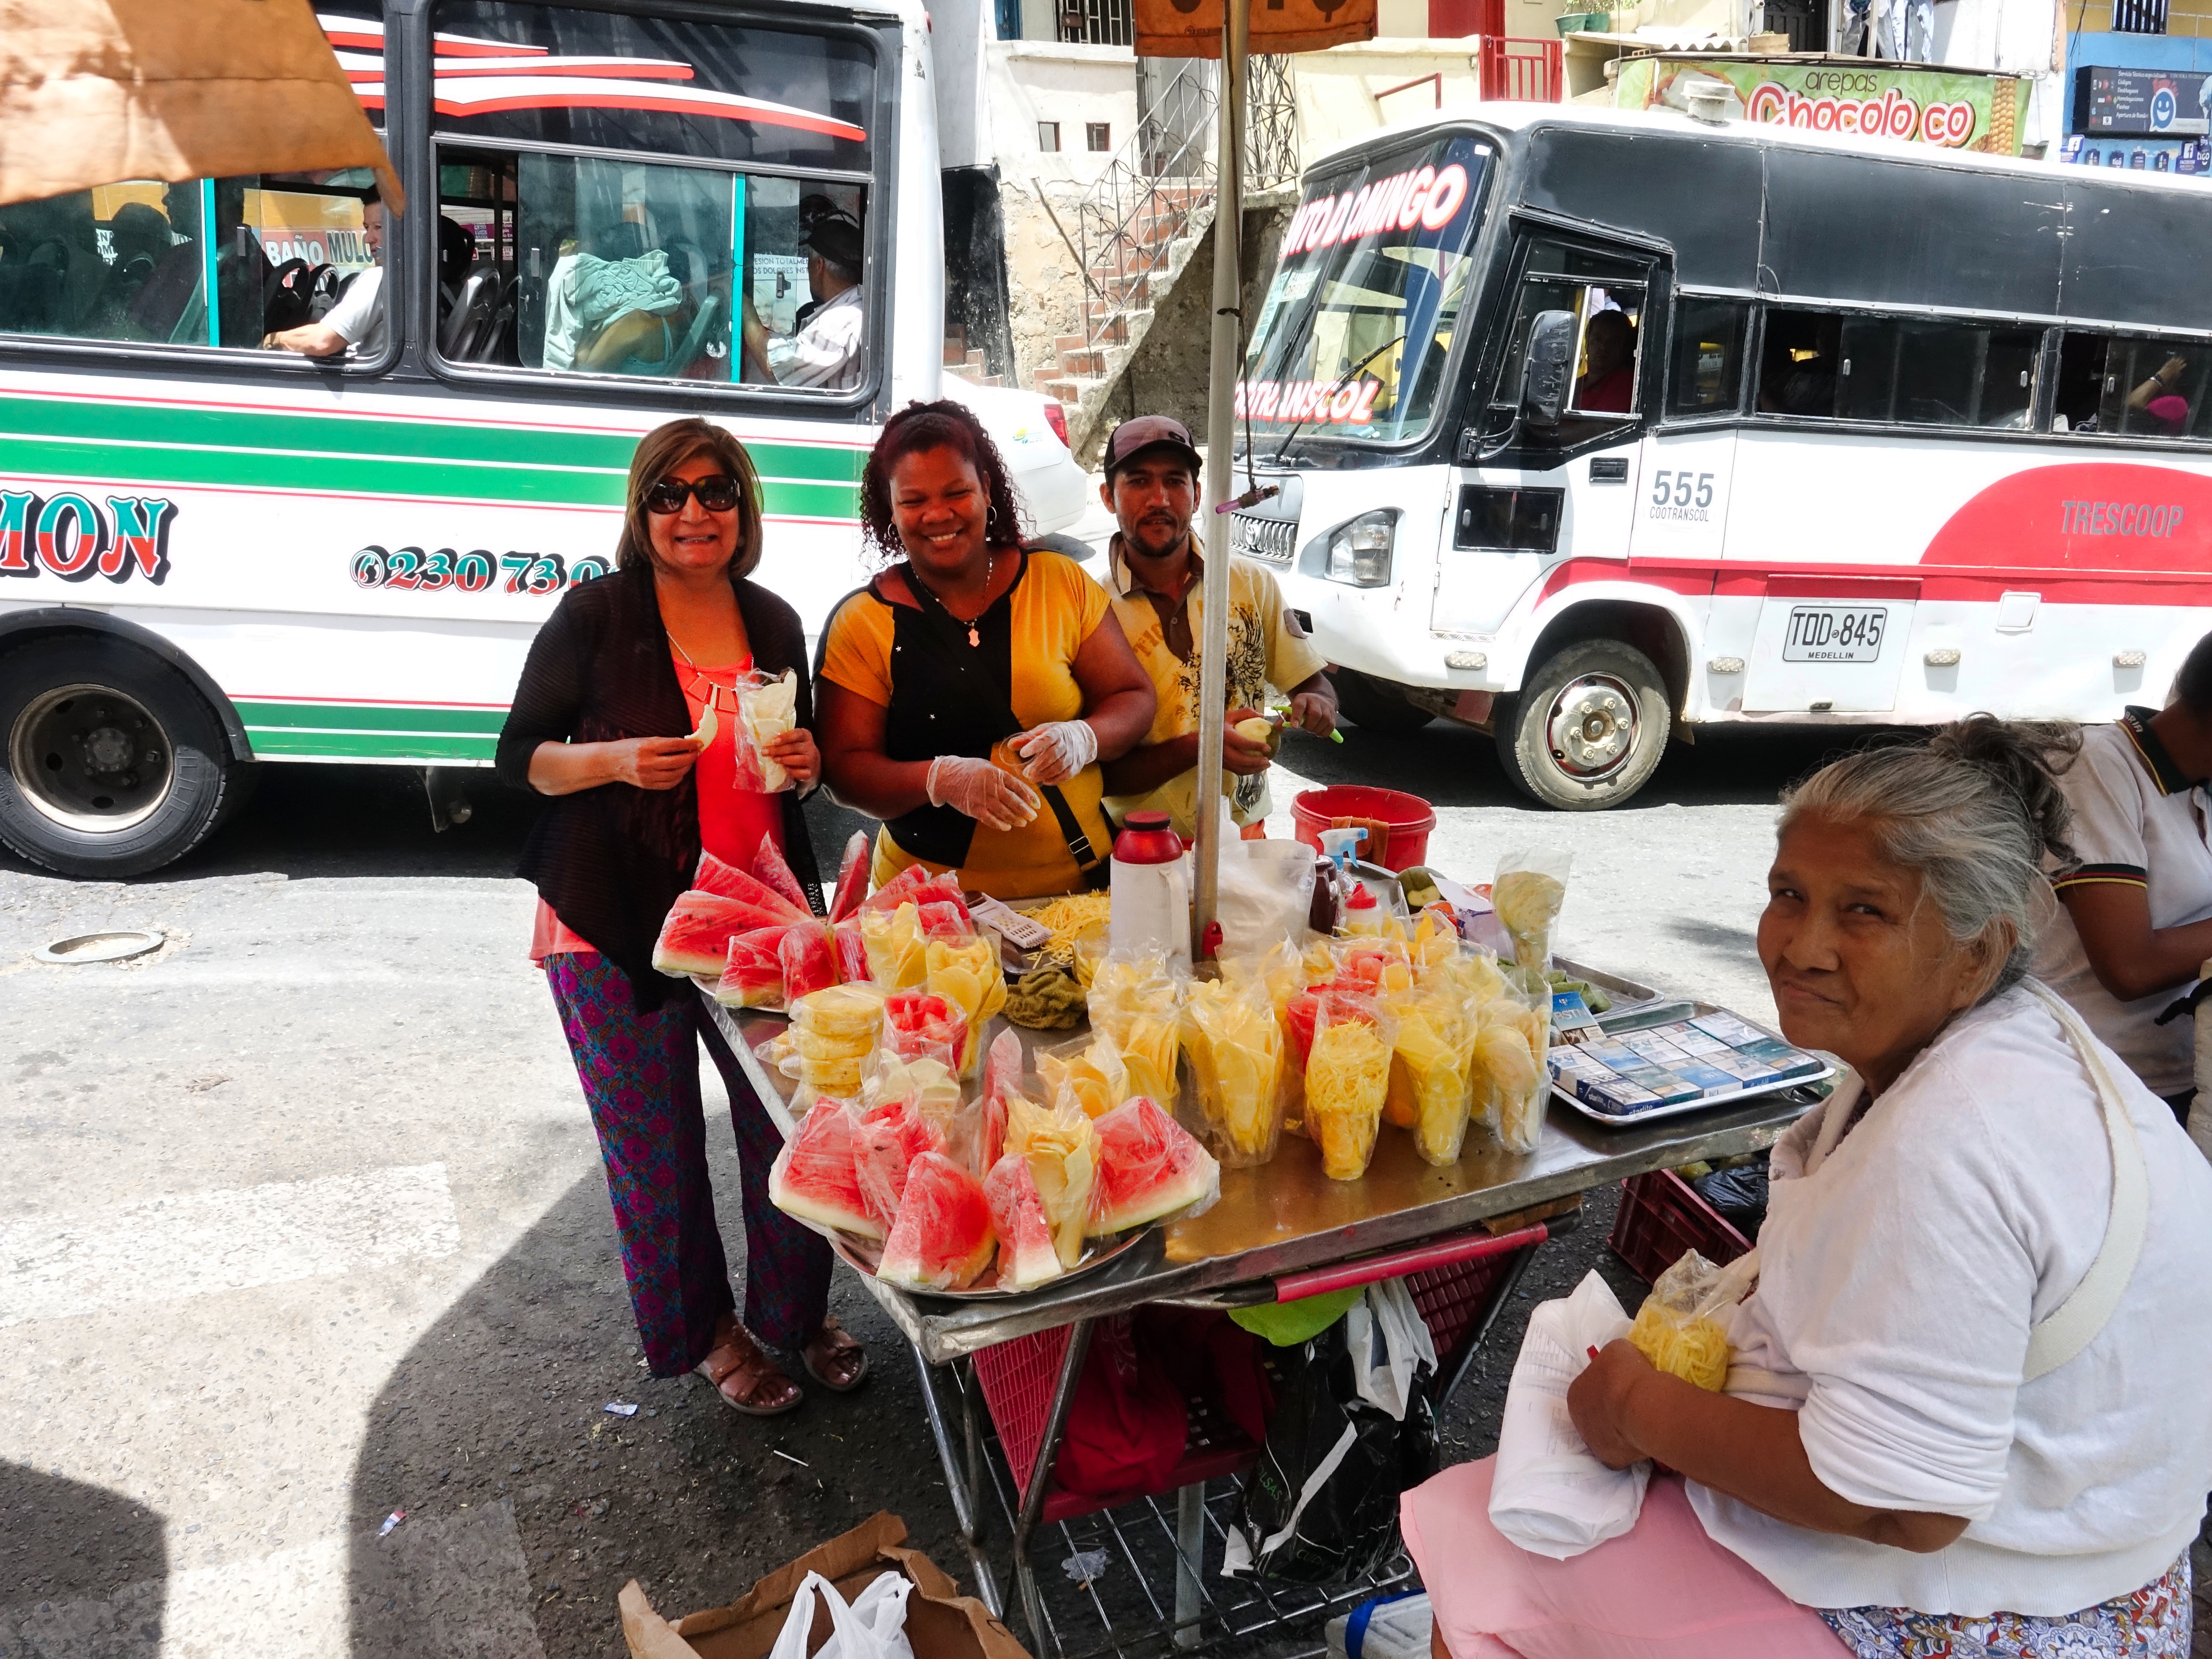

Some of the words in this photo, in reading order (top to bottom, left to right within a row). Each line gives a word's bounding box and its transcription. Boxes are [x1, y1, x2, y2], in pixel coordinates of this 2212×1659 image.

[1805, 71, 1877, 96] arepas
[1320, 164, 1468, 247] DOMINGO
[265, 234, 324, 266] BAÑO
[1234, 380, 1379, 425] OOTRANSCOL
[1653, 470, 1714, 508] 555
[1650, 506, 1709, 522] COOTRANSCOL
[2061, 500, 2184, 538] TRESCOOP
[1258, 1459, 1283, 1500] OLSAS
